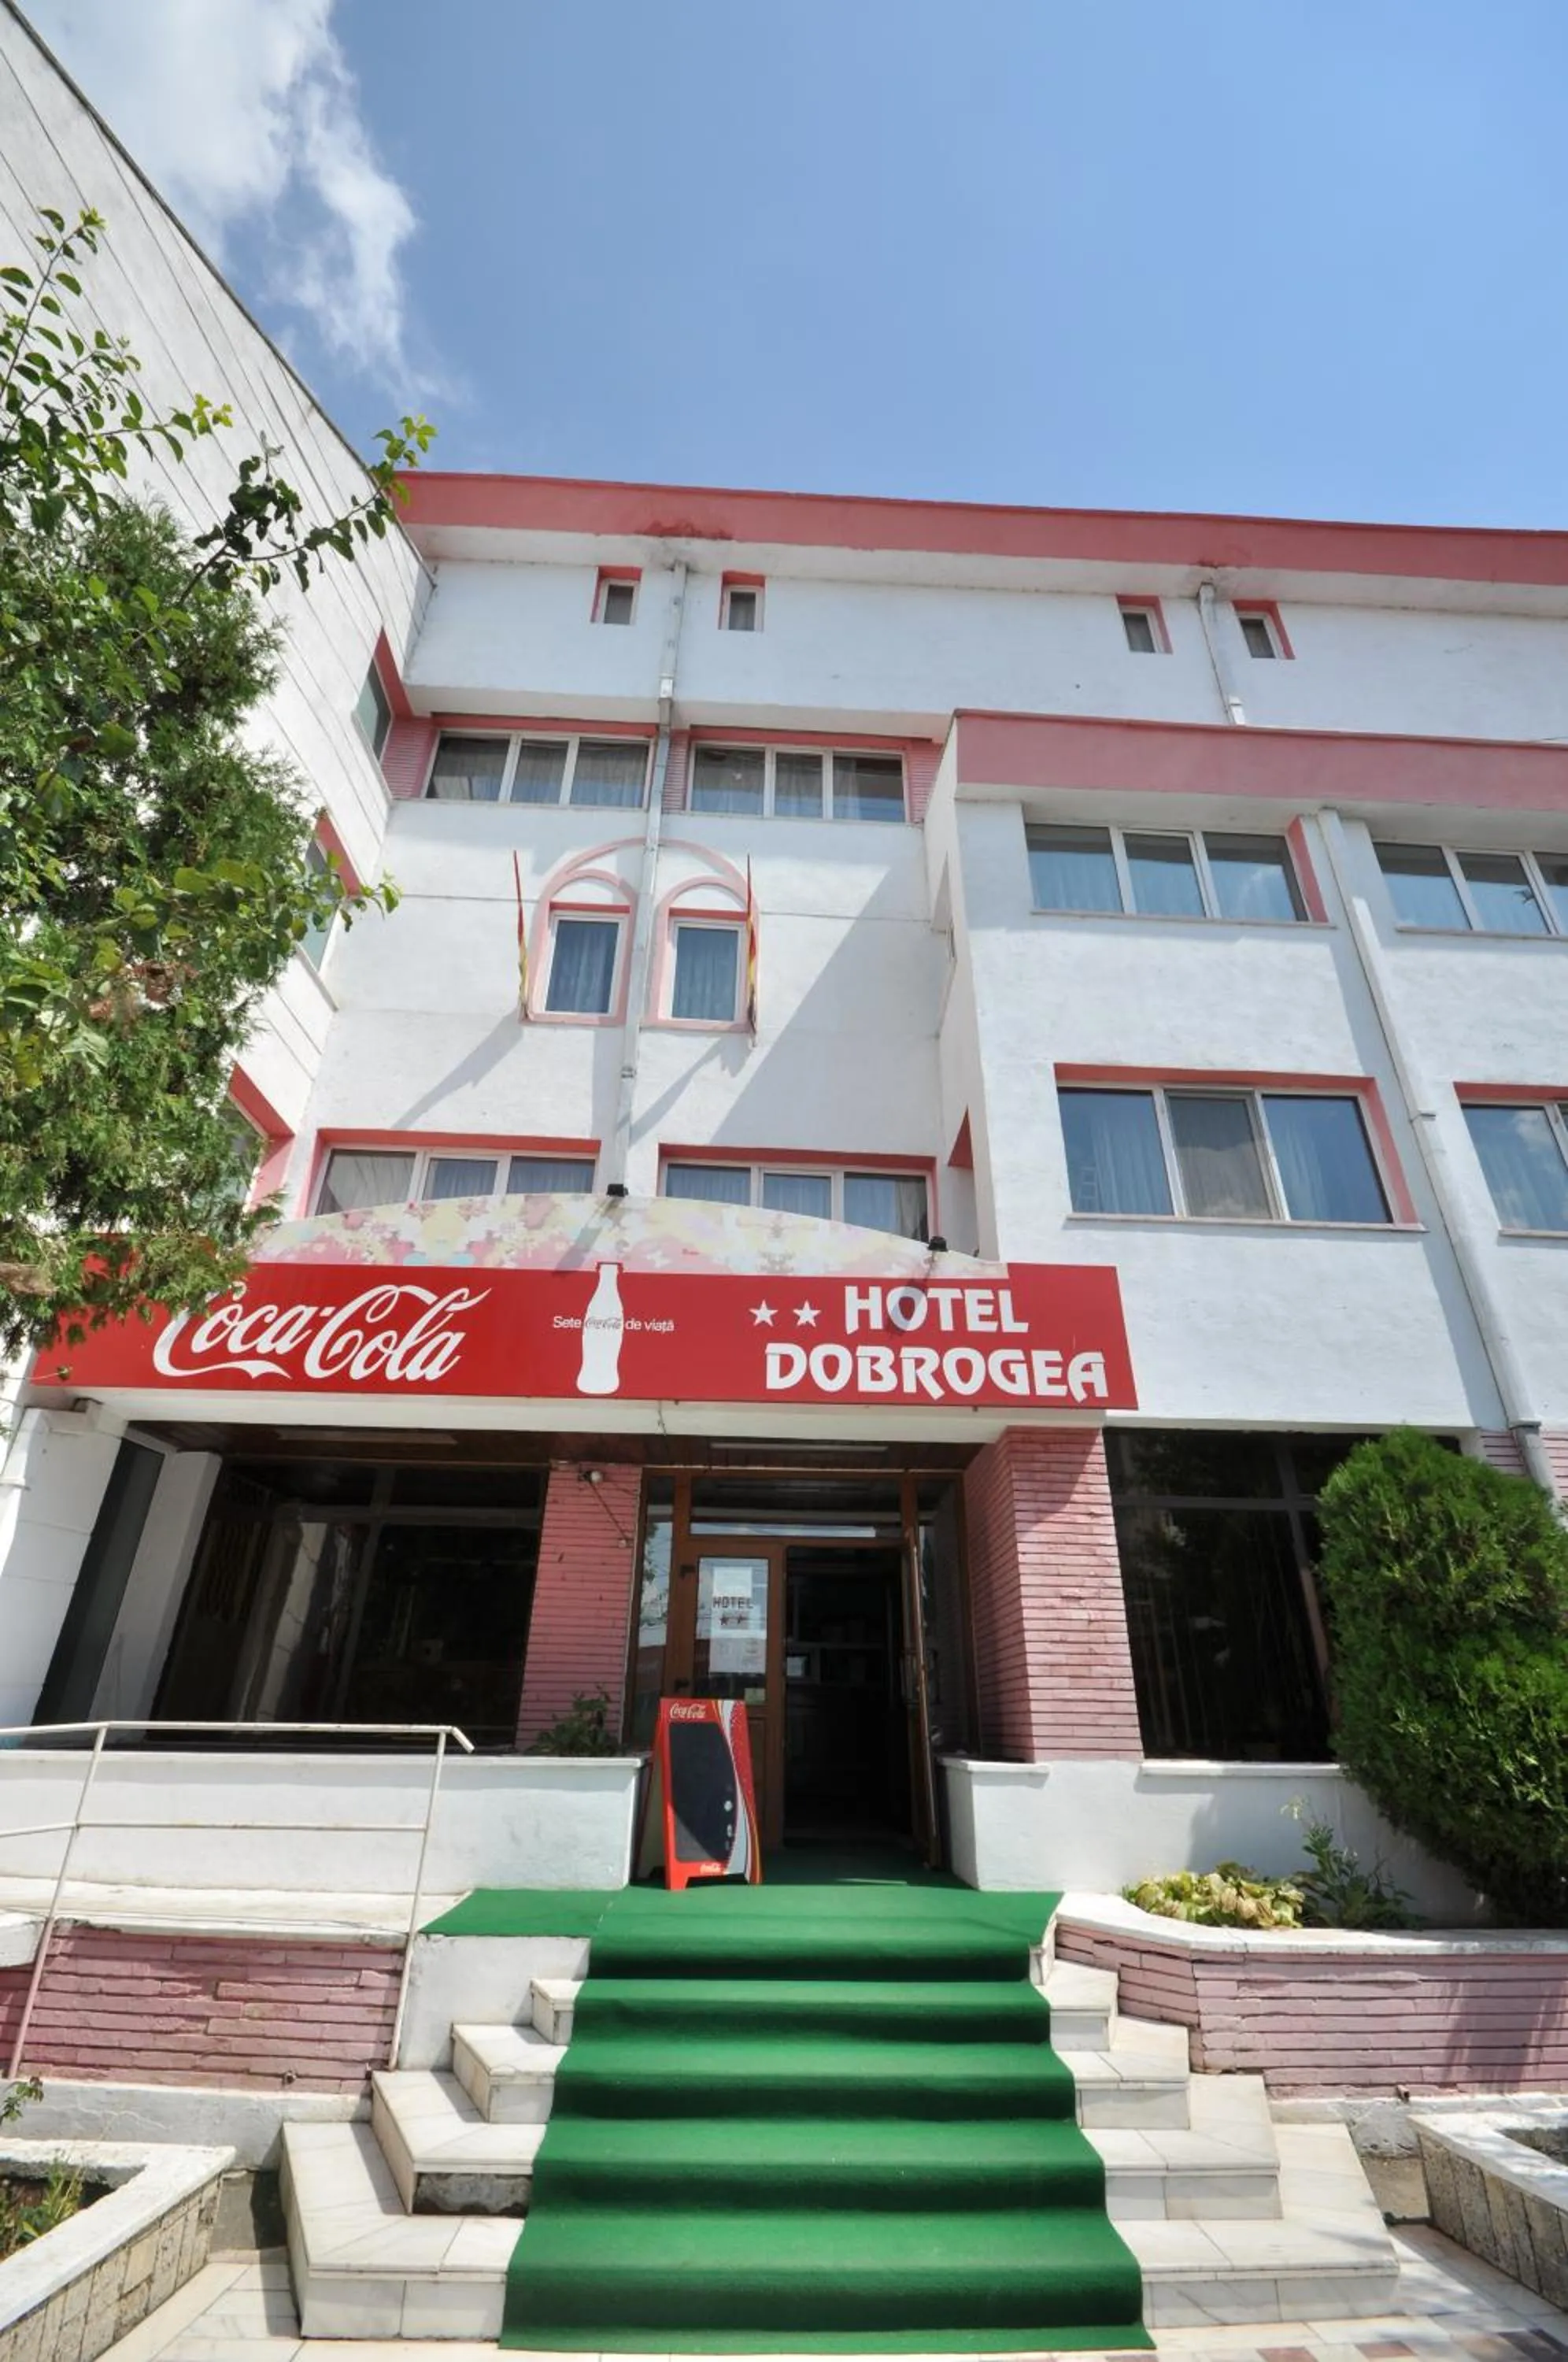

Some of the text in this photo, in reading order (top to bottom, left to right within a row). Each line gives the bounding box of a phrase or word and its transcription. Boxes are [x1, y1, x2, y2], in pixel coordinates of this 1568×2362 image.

[153, 1282, 492, 1380] Coca-Cola
[553, 1316, 581, 1328] Sete
[625, 1318, 642, 1331] de
[845, 1285, 1029, 1335] HOTEL
[765, 1342, 1109, 1403] DOBROGEA
[713, 1596, 753, 1609] HOTEL
